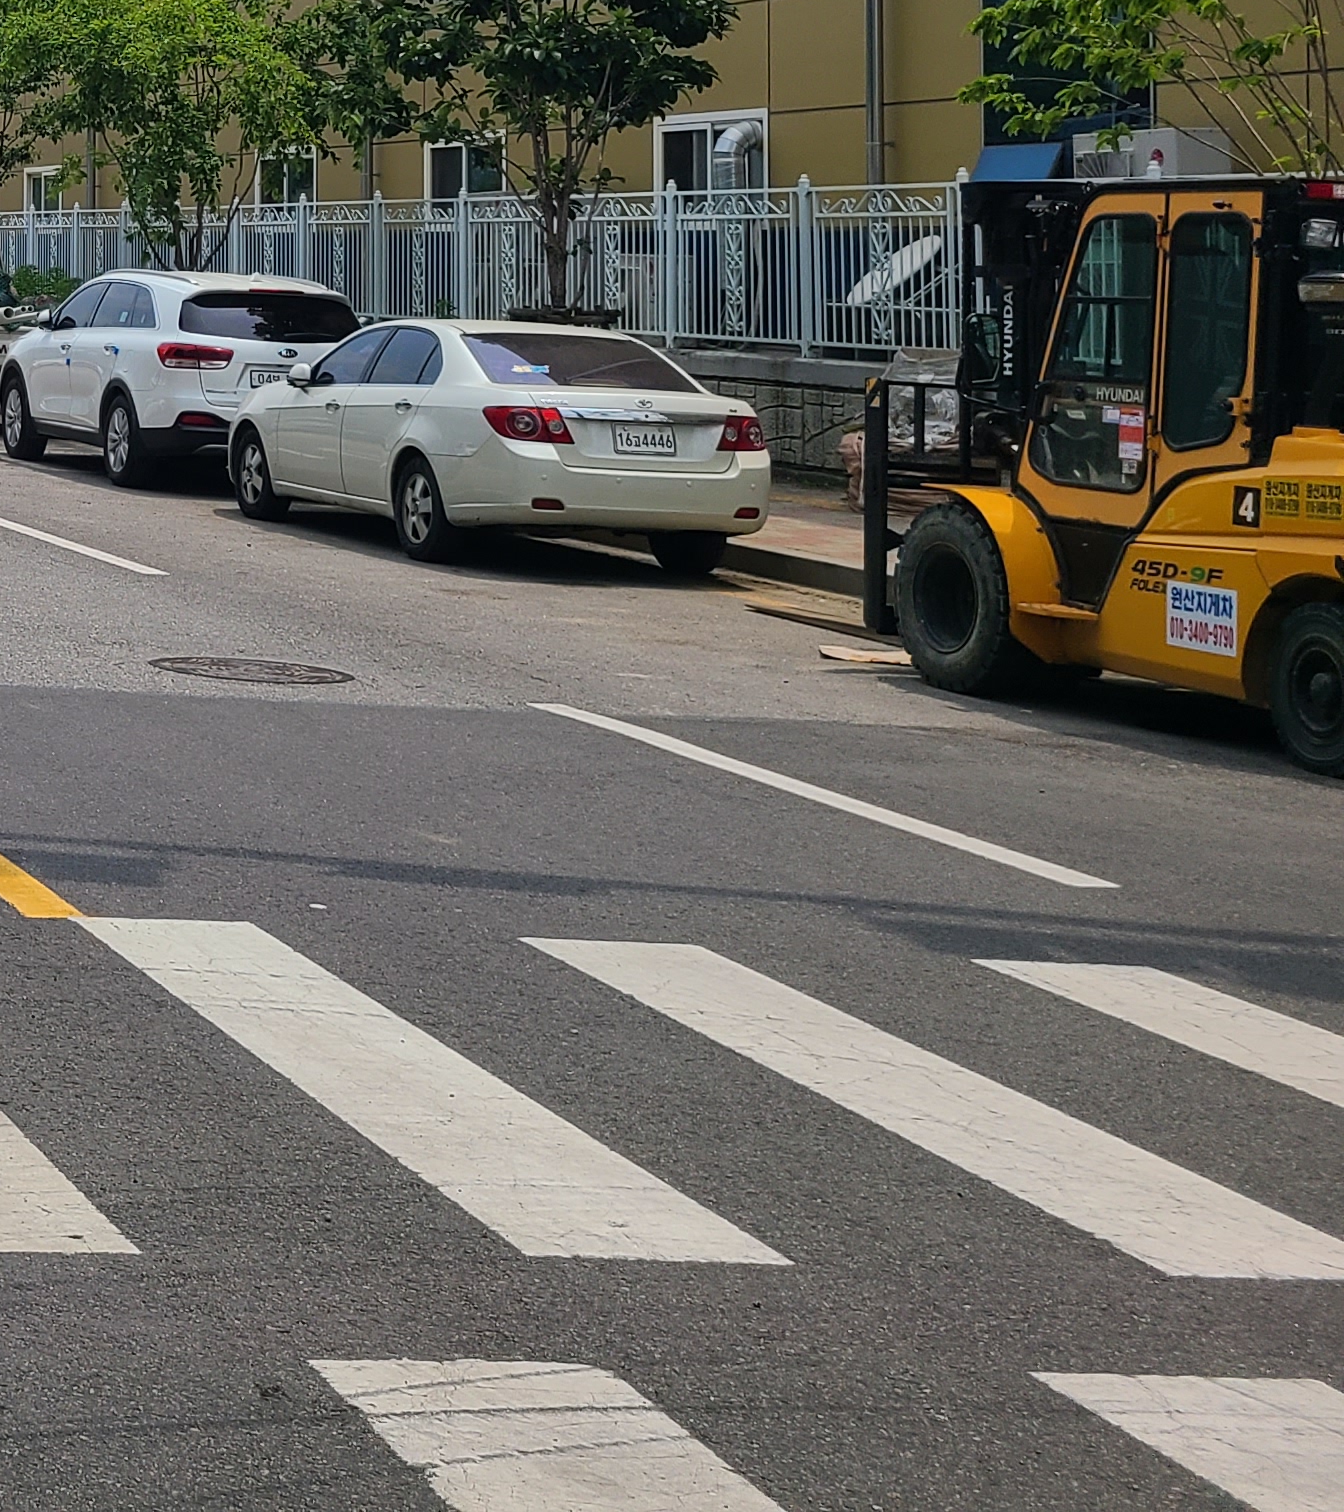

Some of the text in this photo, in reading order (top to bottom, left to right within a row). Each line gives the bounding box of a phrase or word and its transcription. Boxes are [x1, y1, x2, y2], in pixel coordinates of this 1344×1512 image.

[1002, 284, 1014, 377] HYUNDAI
[1095, 386, 1145, 403] HYUNDAI
[1238, 492, 1255, 523] 4
[1131, 559, 1224, 585] 45D-9F
[1170, 586, 1234, 620] 원산지게차
[1169, 615, 1235, 649] 010-3400-9790
